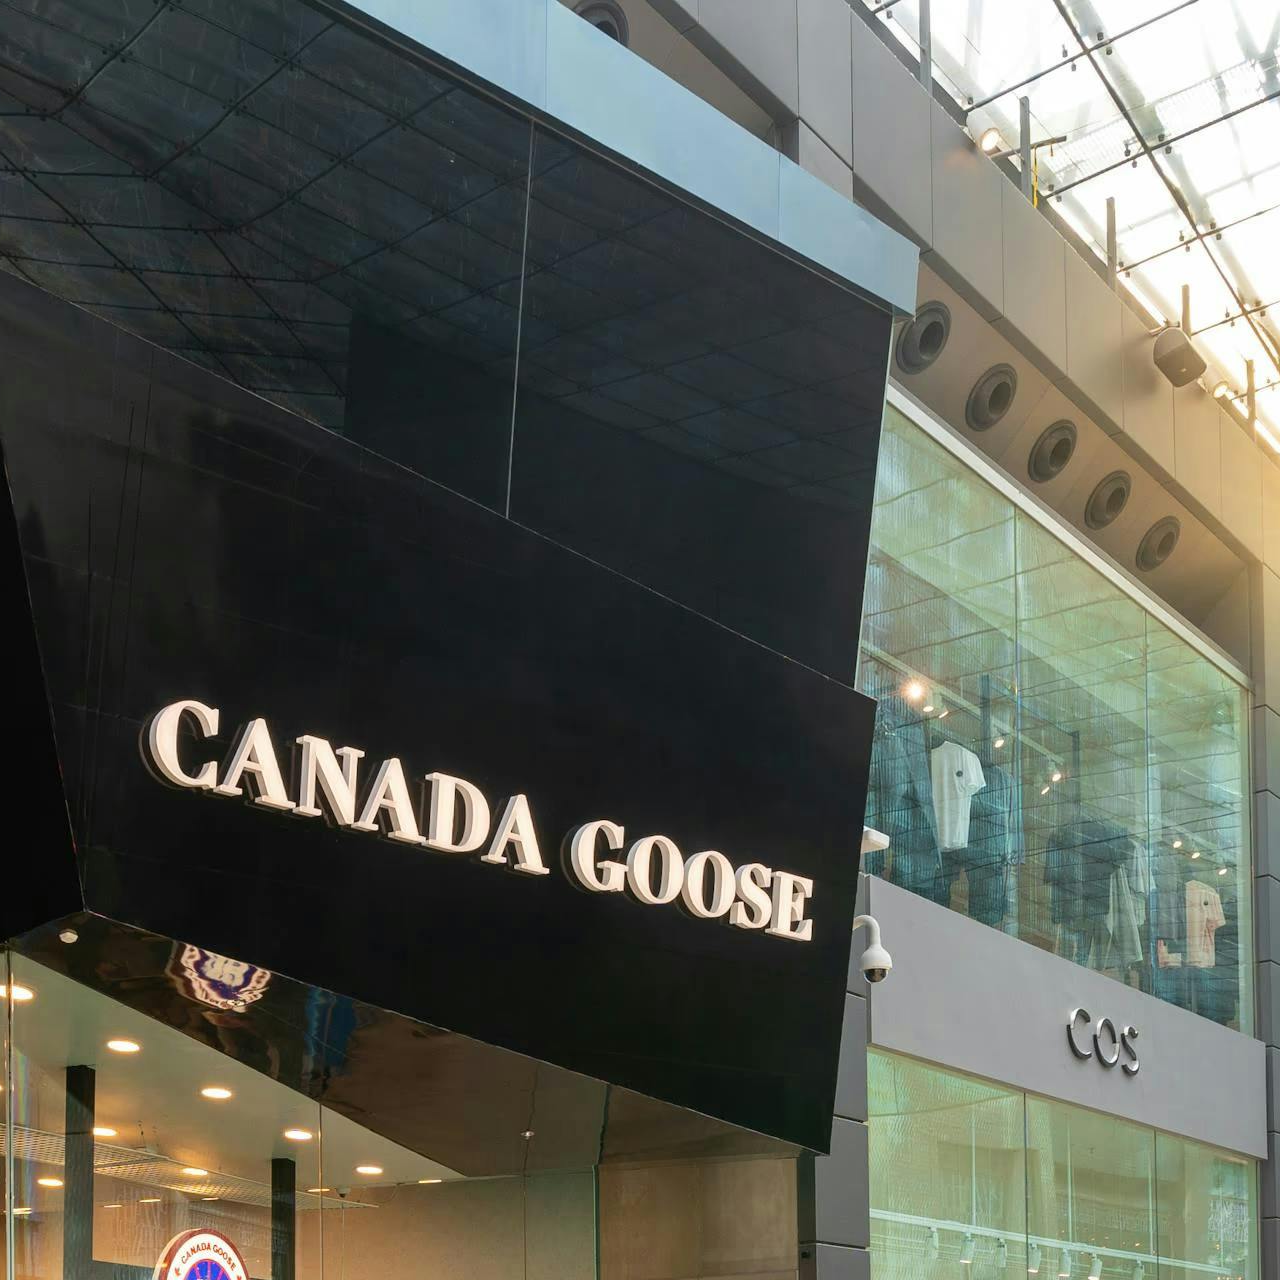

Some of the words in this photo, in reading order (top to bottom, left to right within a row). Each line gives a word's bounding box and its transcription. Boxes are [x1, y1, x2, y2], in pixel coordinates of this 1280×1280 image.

[145, 699, 549, 875] CANADA
[568, 819, 814, 942] GOOSE
[1066, 1007, 1140, 1077] COS
[181, 1242, 211, 1264] CANADA
[213, 1244, 236, 1271] GOOSE
